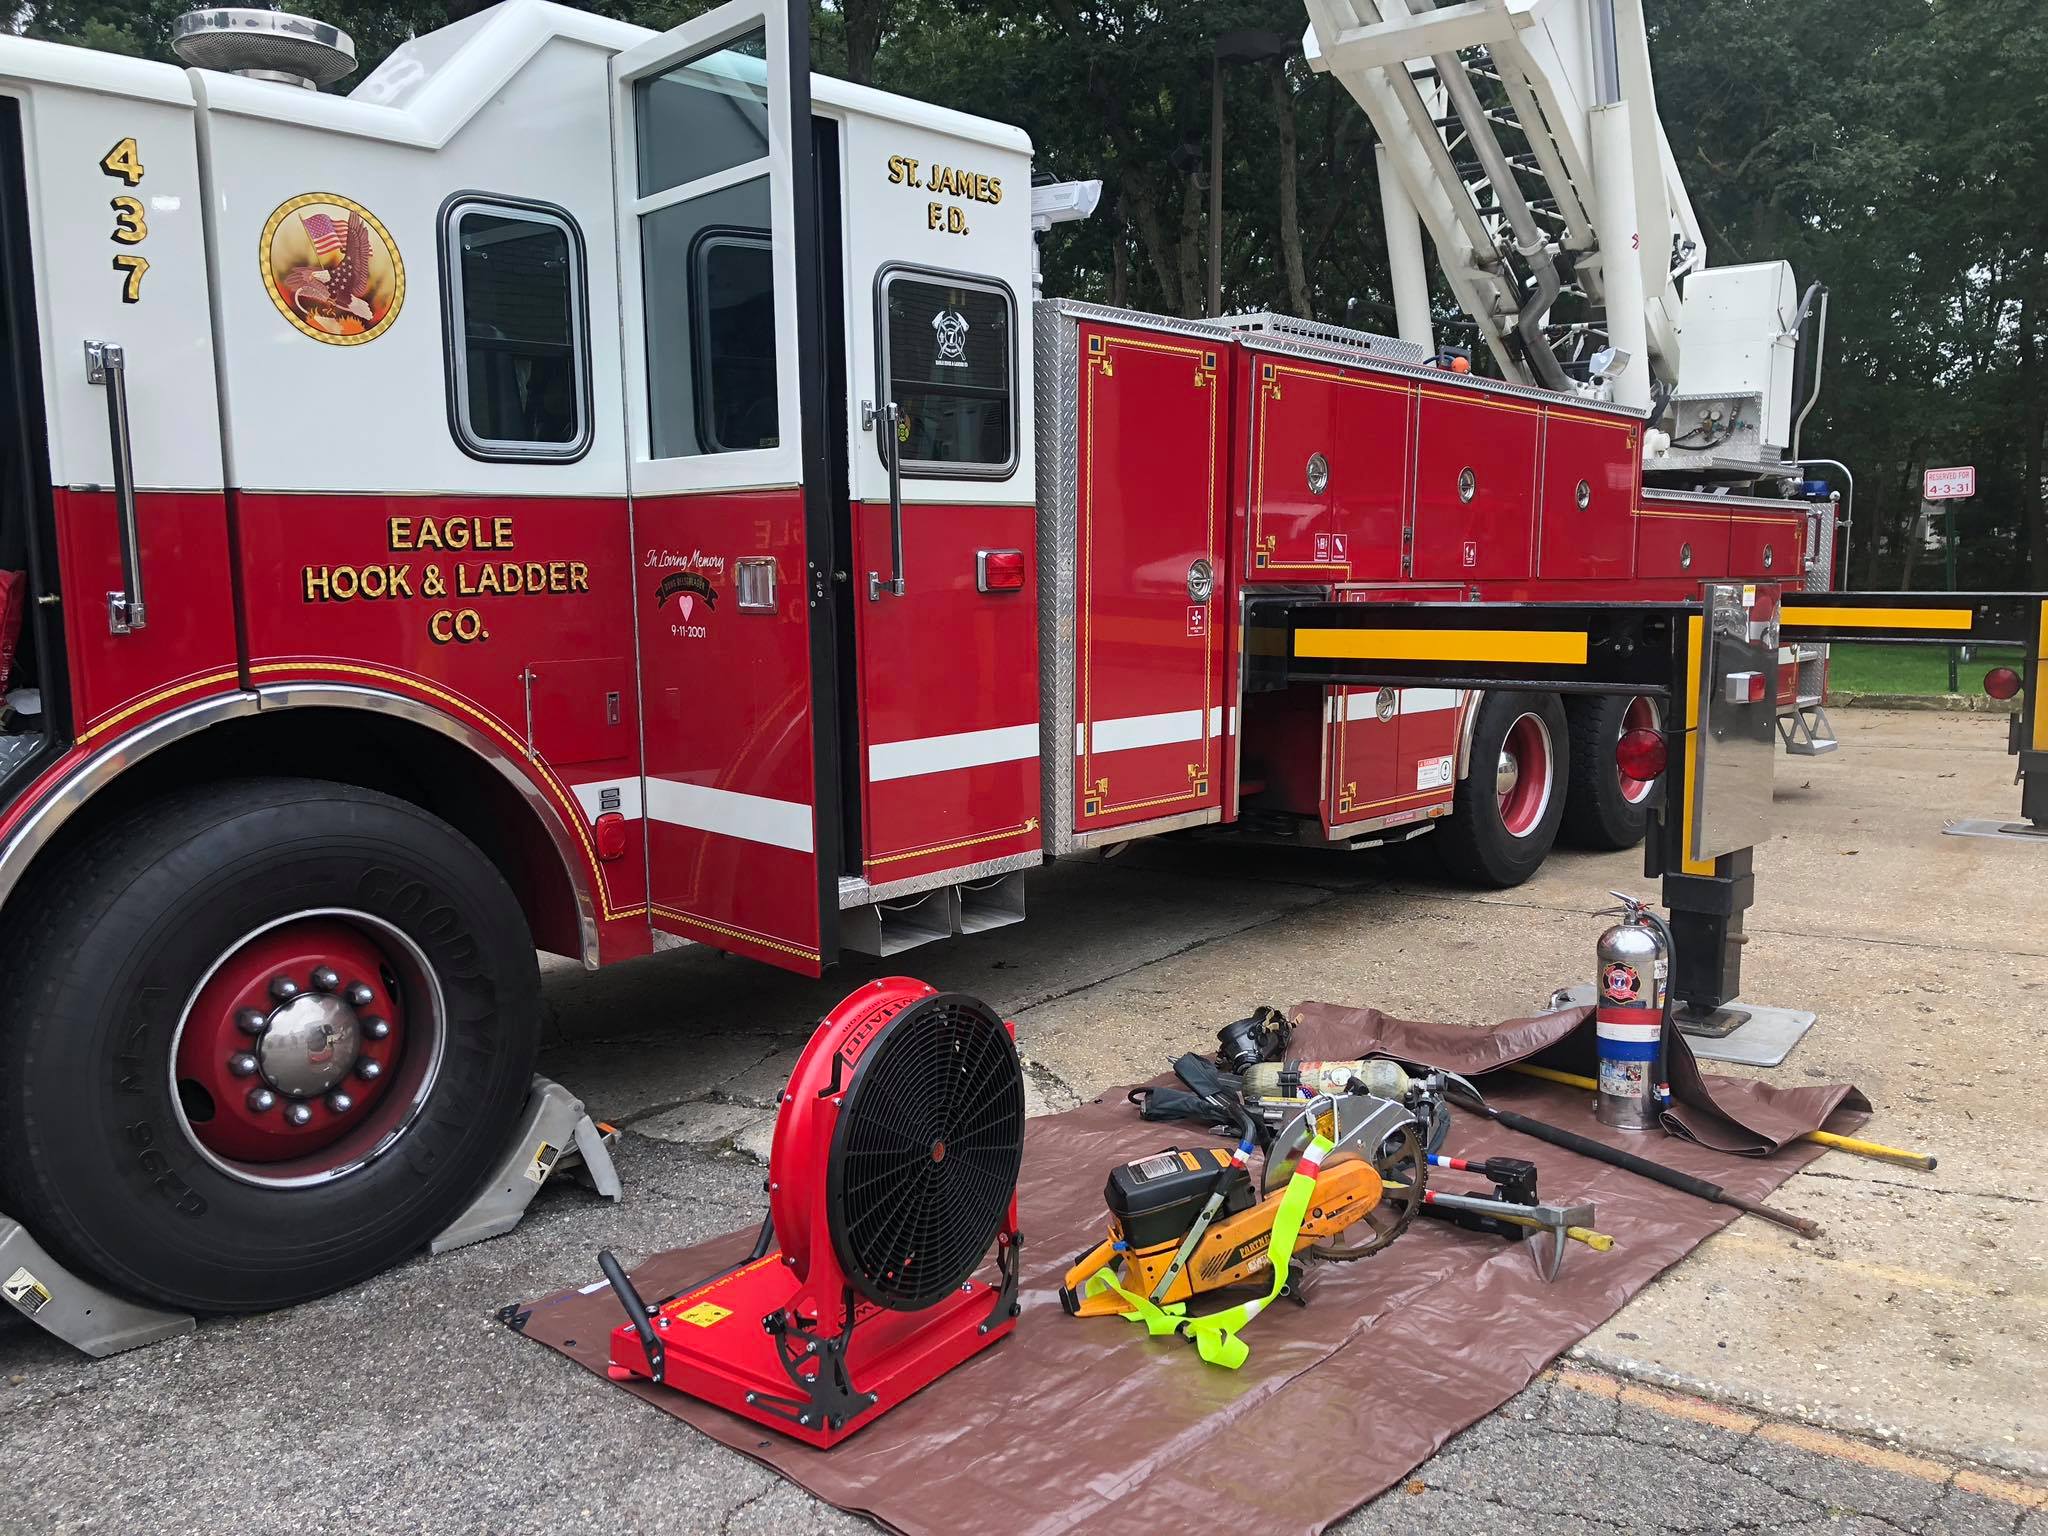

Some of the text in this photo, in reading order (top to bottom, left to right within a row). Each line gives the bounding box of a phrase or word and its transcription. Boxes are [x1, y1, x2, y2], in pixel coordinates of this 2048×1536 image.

[887, 155, 1003, 205] ST. JAMES
[928, 201, 970, 236] F.D.
[1928, 471, 1970, 481] RESERVED FOR
[1929, 483, 1970, 494] 4-3-31
[388, 516, 515, 551] EAGLE
[644, 548, 725, 575] In Loving Memory
[303, 561, 590, 603] HOOK & LADDER
[429, 608, 490, 645] CO.
[671, 624, 706, 639] 9-11-2001
[357, 865, 498, 1181] GOODYEAR
